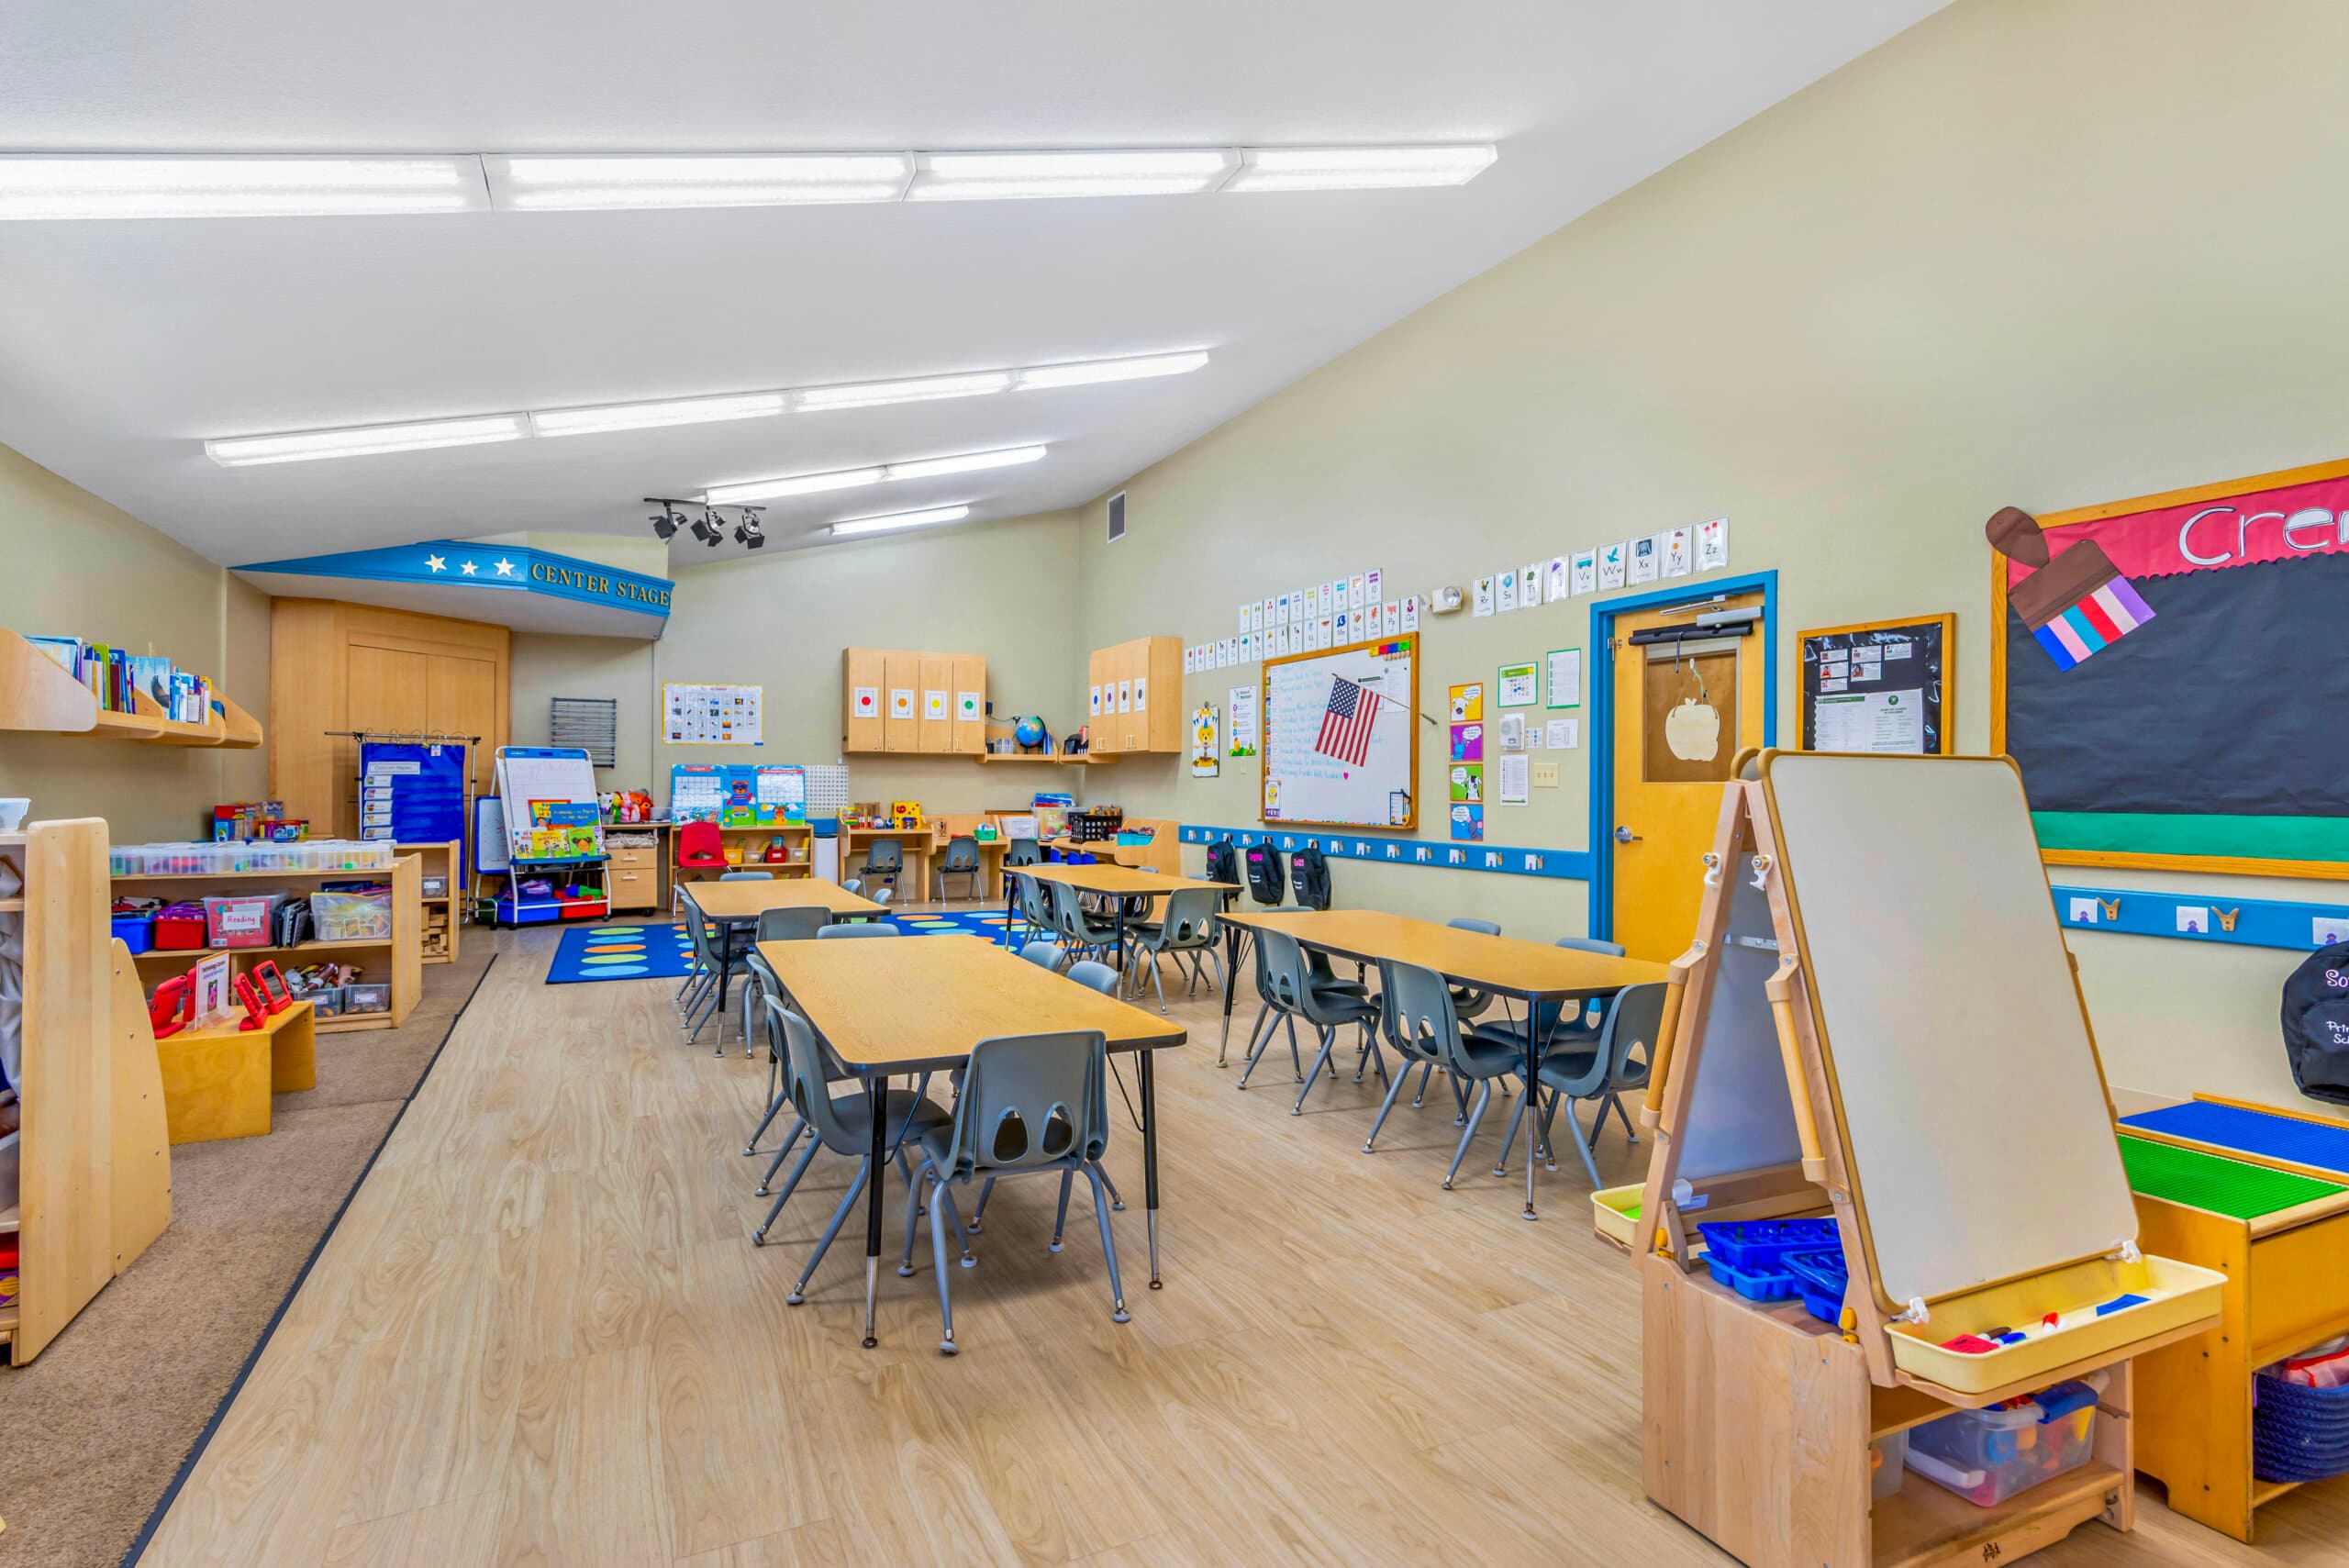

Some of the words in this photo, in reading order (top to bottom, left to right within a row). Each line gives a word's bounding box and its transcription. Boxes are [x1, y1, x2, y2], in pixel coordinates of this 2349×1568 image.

[1706, 543, 1719, 555] Zz
[1638, 559, 1649, 570] Xx
[1670, 551, 1683, 566] Yy
[1578, 571, 1590, 581] Vv
[531, 563, 609, 594] CENTER
[617, 581, 670, 606] STAGE
[227, 916, 256, 925] Reading
[2325, 969, 2349, 988] So
